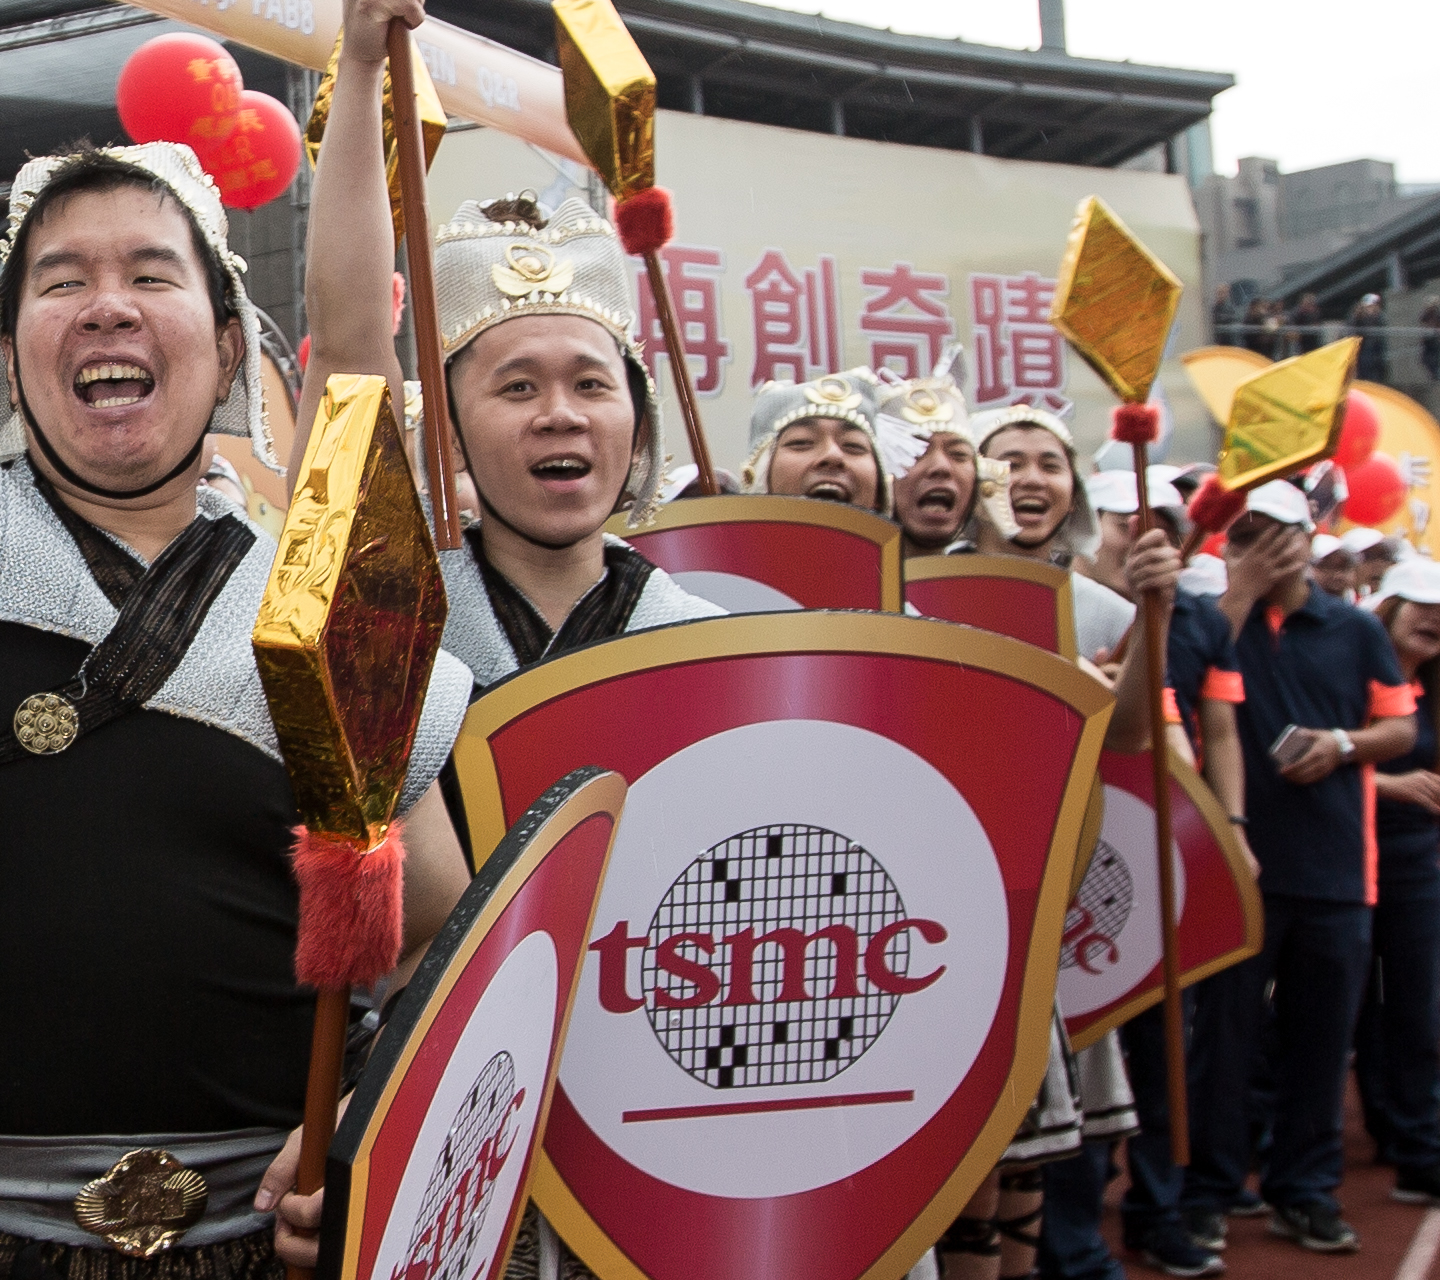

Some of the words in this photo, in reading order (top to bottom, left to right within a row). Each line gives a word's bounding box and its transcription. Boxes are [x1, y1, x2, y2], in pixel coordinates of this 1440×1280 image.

[633, 246, 1067, 411] 再創奇蹟
[587, 917, 949, 1014] tsmc
